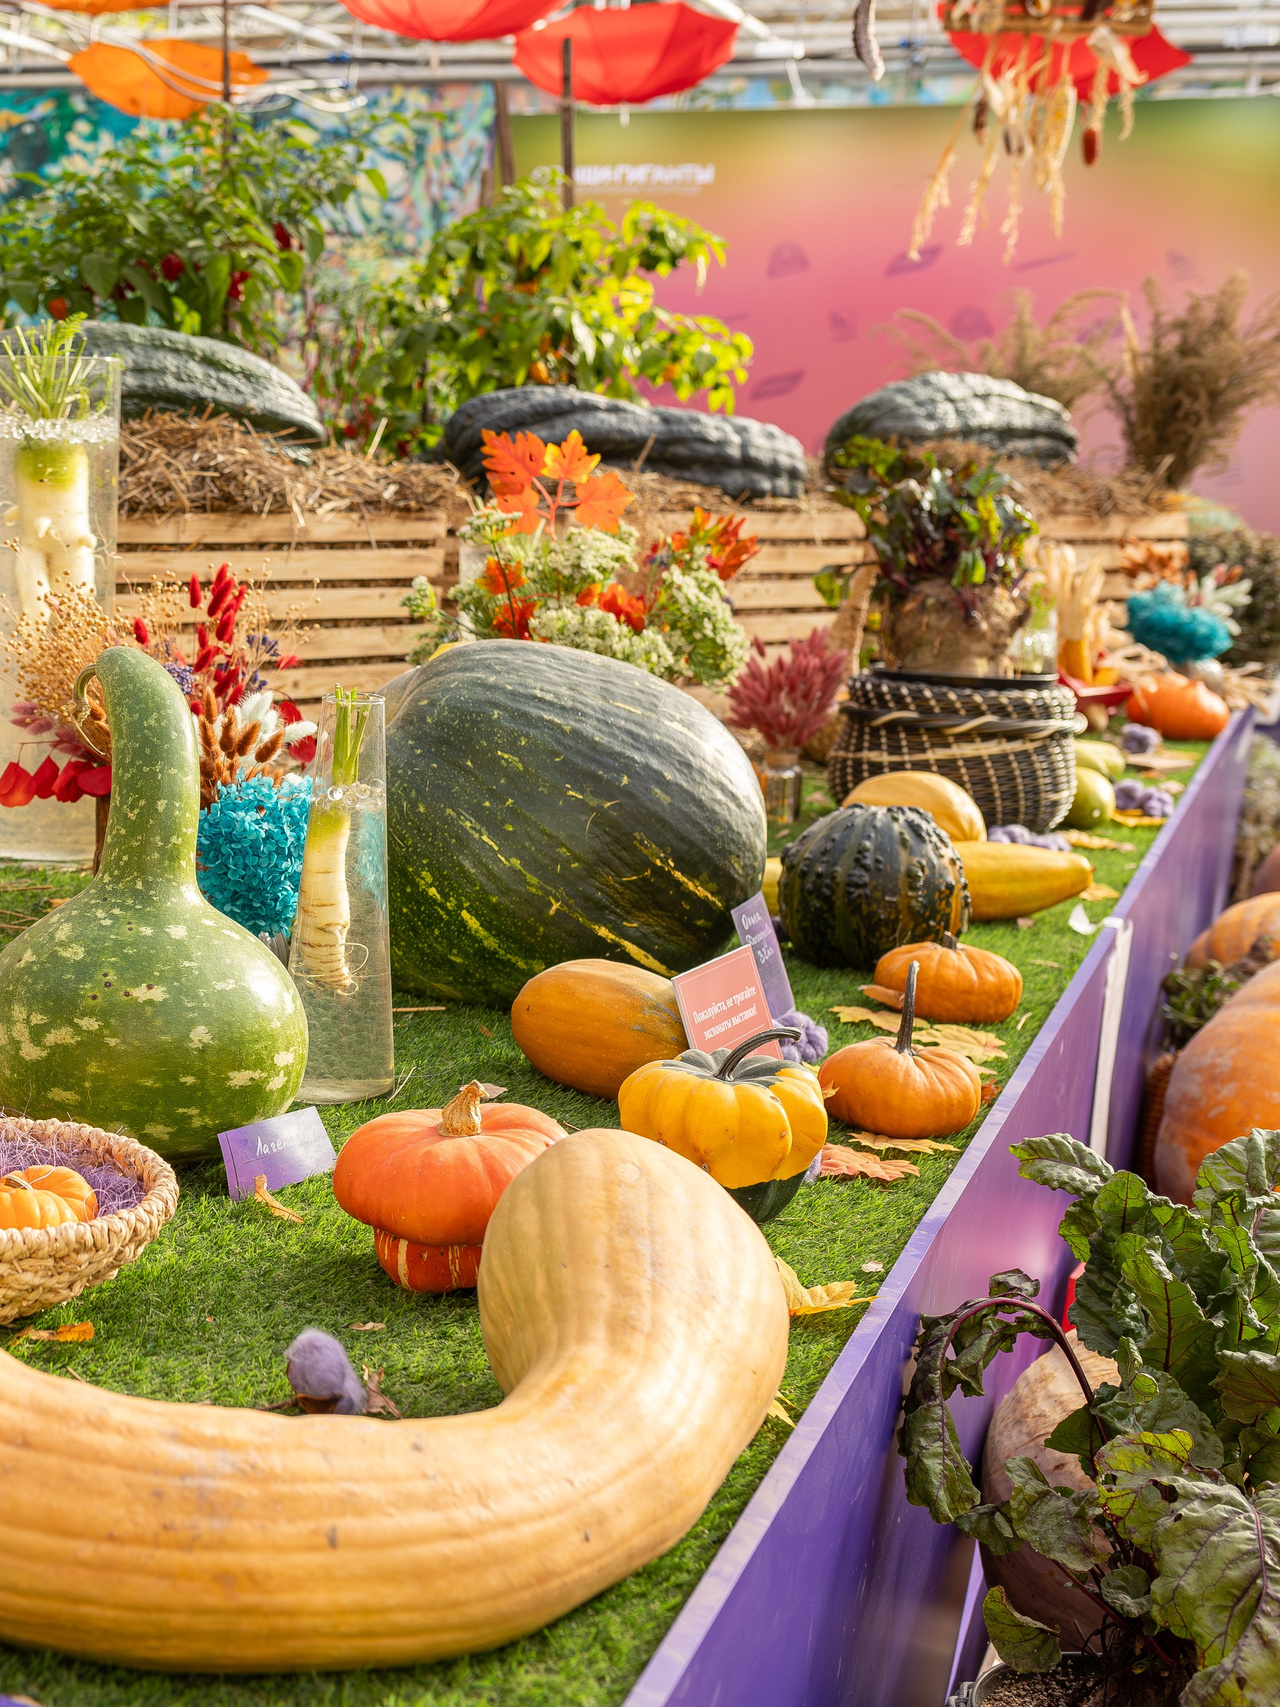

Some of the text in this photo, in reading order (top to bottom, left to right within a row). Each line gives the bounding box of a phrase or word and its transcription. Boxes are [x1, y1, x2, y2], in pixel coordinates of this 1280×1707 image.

[692, 986, 757, 1024] Пожалуйста, не трогайте
[703, 1002, 758, 1040] экспонаты выставки!
